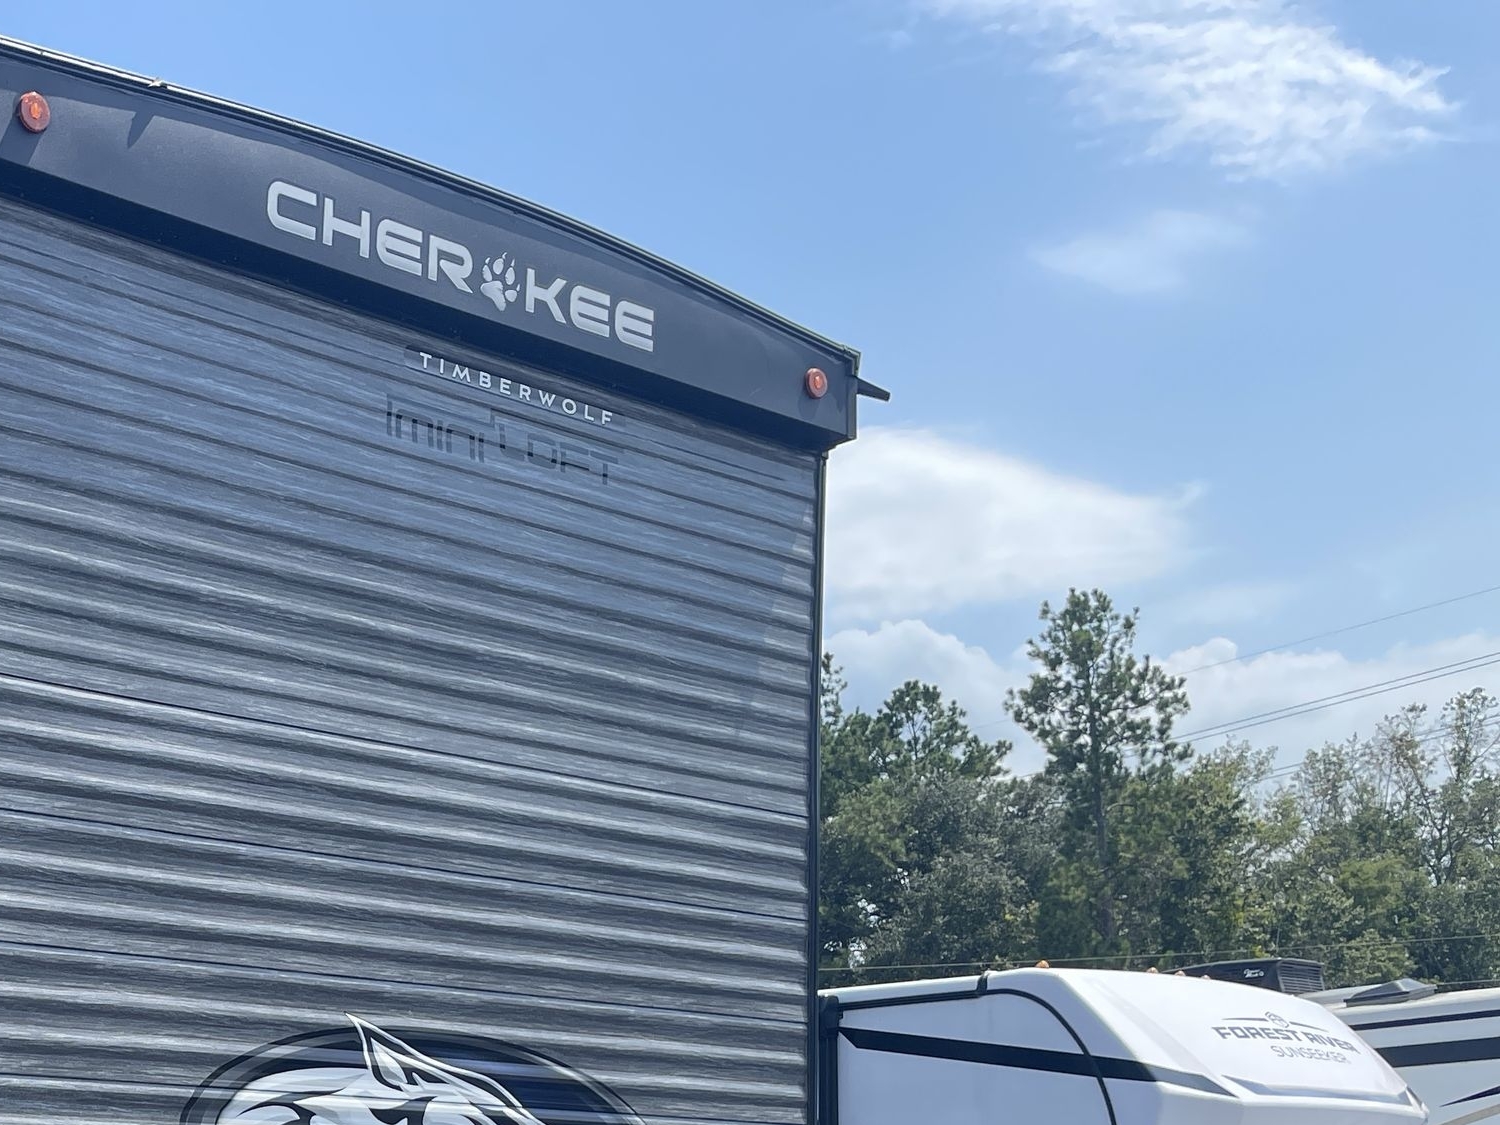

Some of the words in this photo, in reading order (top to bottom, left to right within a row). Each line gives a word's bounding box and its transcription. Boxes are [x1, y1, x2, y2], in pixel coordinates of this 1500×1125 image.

[418, 351, 615, 426] TIMBERWOLF
[1211, 1026, 1303, 1043] FOREST
[1301, 1030, 1361, 1055] RIVER
[1270, 1045, 1348, 1064] SUNSEEKER
